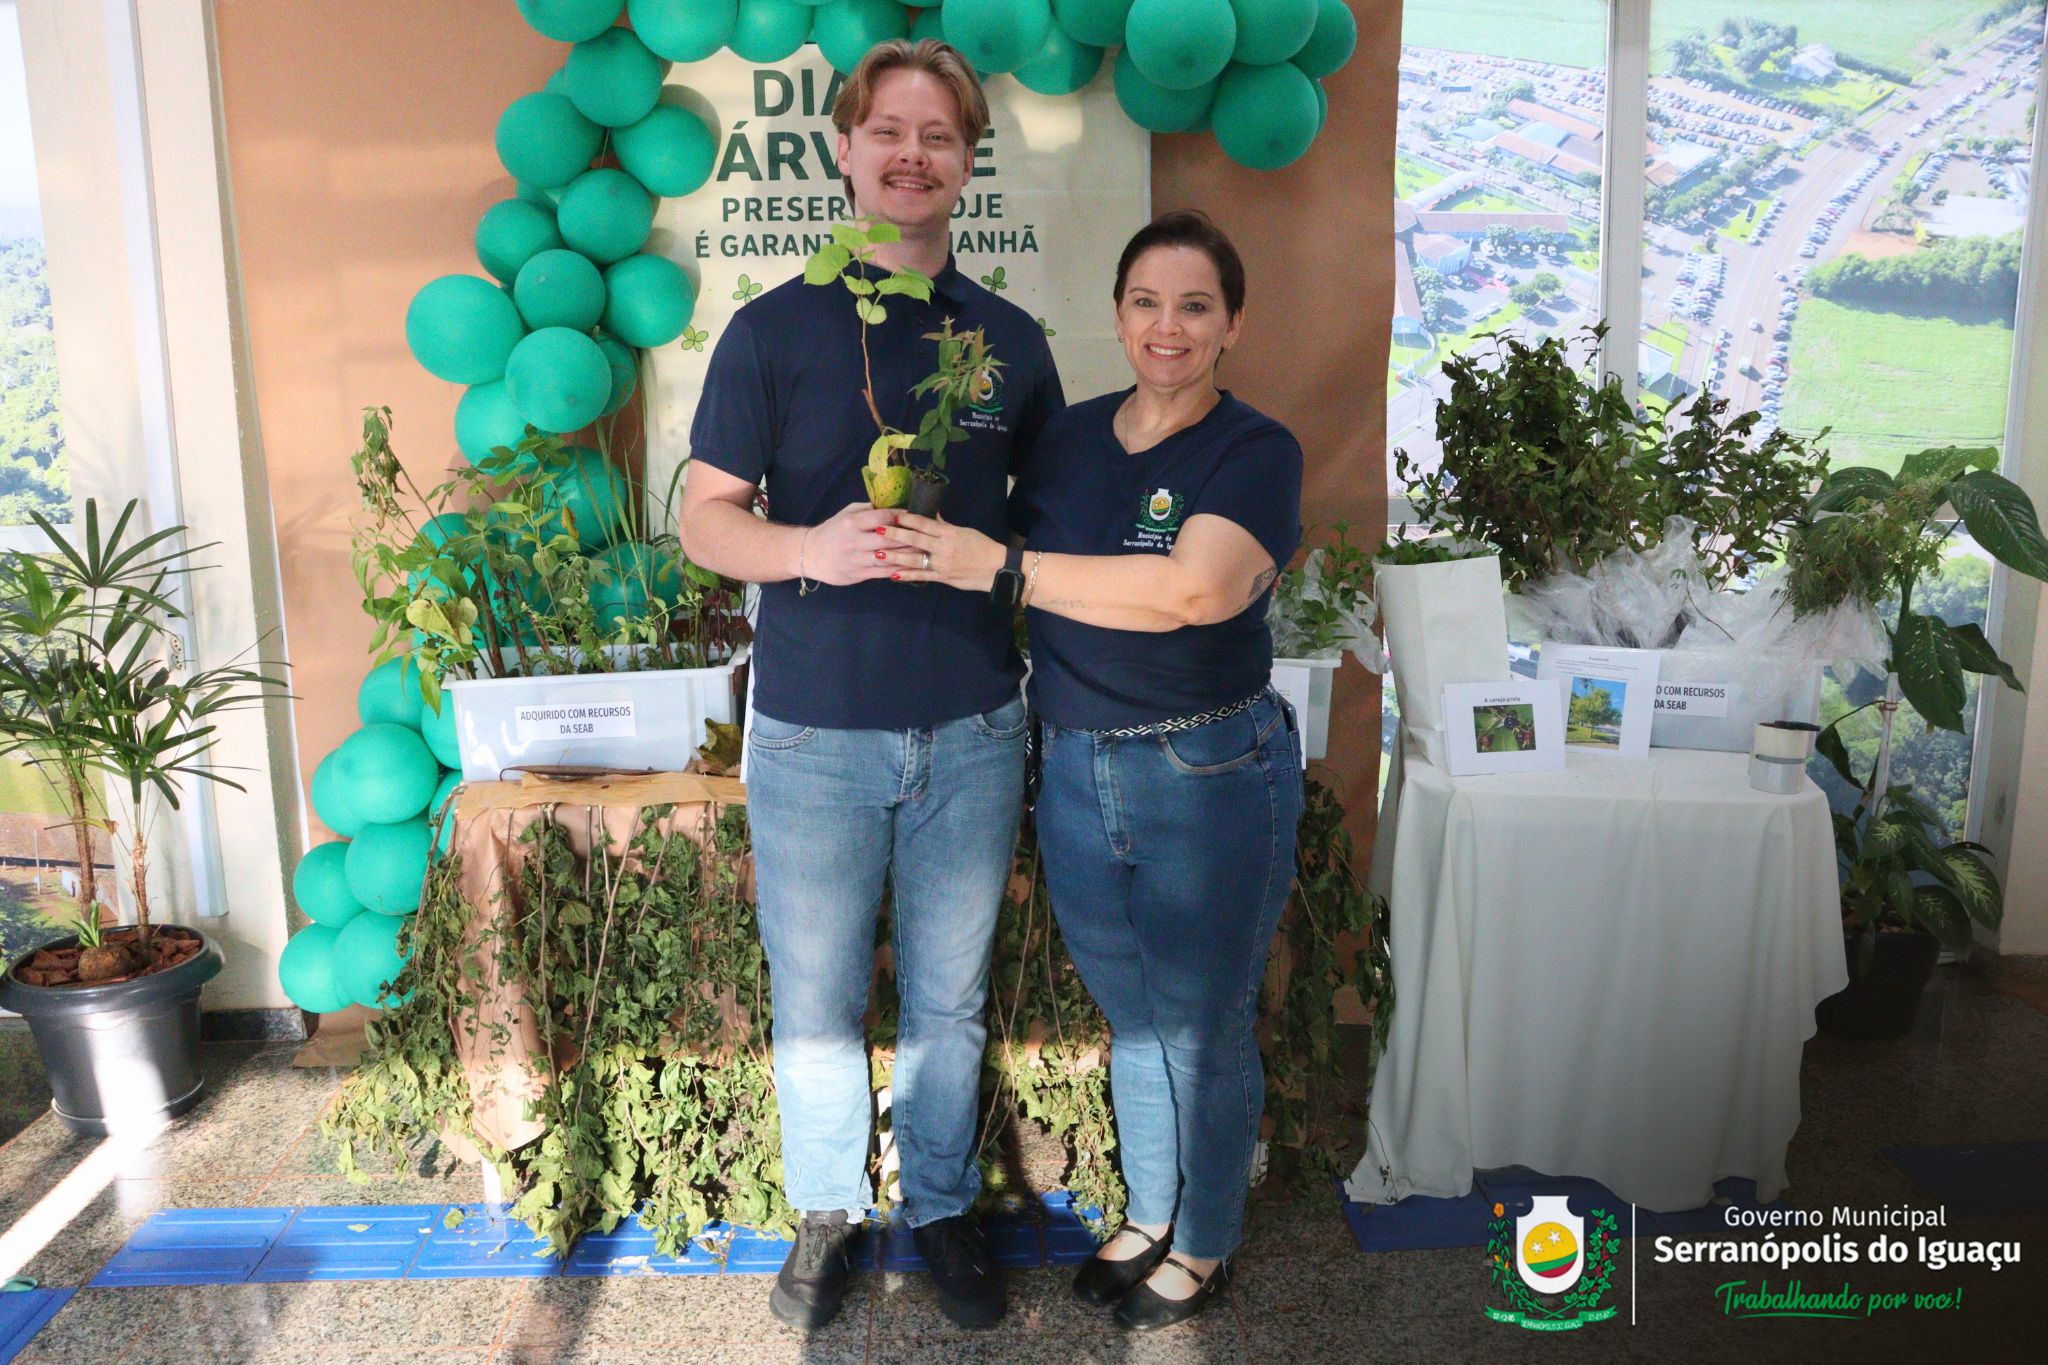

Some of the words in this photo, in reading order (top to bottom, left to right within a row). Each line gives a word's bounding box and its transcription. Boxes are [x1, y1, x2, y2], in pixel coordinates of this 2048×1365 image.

[695, 229, 710, 258] É
[1664, 686, 1682, 696] COM
[1683, 687, 1726, 698] RECURSOS
[1654, 699, 1664, 709] DA
[1666, 700, 1687, 710] SEAB
[520, 709, 566, 722] ADQUIRIDO
[568, 708, 587, 719] COM
[588, 706, 631, 718] RECURSOS
[560, 724, 571, 734] DA
[573, 723, 594, 734] SEAB
